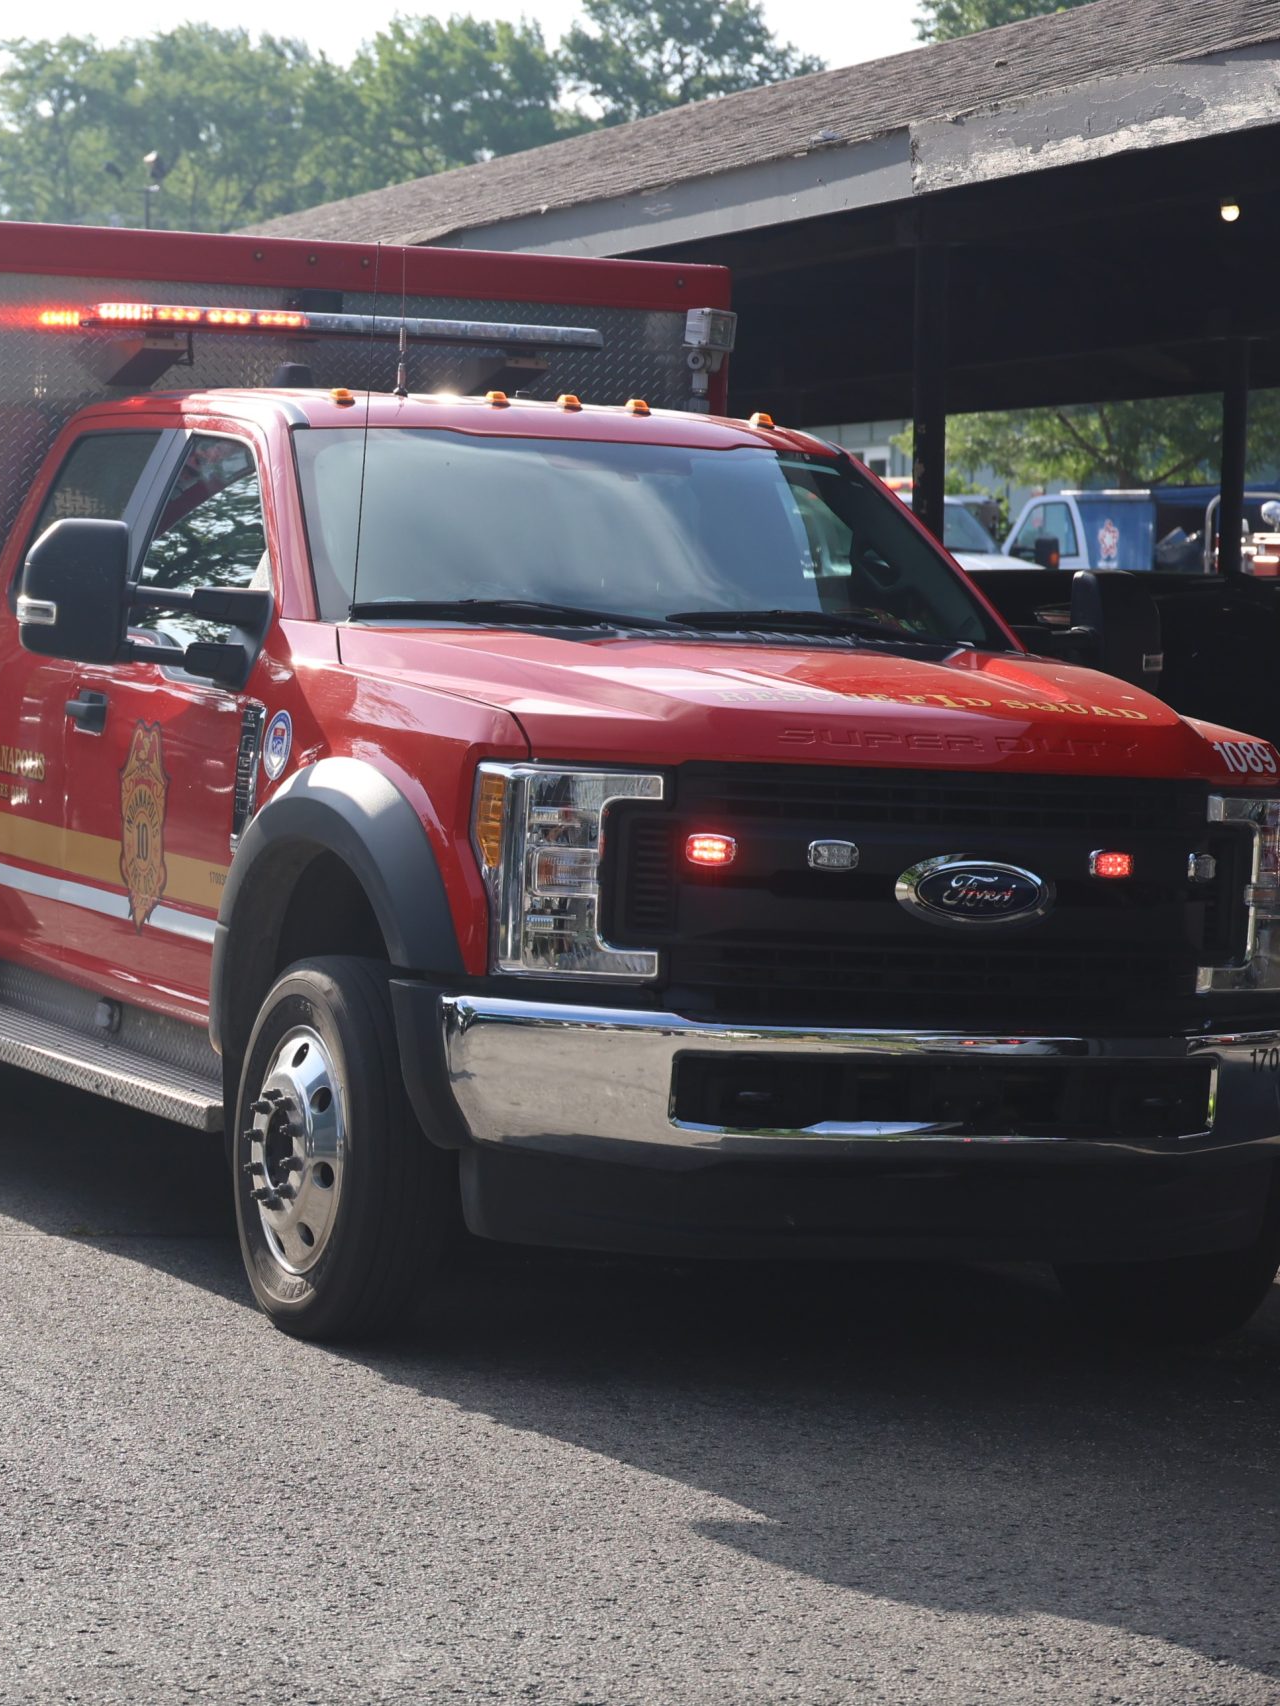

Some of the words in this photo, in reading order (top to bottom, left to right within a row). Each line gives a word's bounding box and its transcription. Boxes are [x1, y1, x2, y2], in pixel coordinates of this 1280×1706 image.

[714, 689, 897, 704] RESCUE
[999, 698, 1148, 721] SQUAD
[777, 727, 986, 752] SUPER
[1213, 740, 1277, 774] 1089
[135, 822, 148, 861] 10
[942, 873, 1018, 908] Ford
